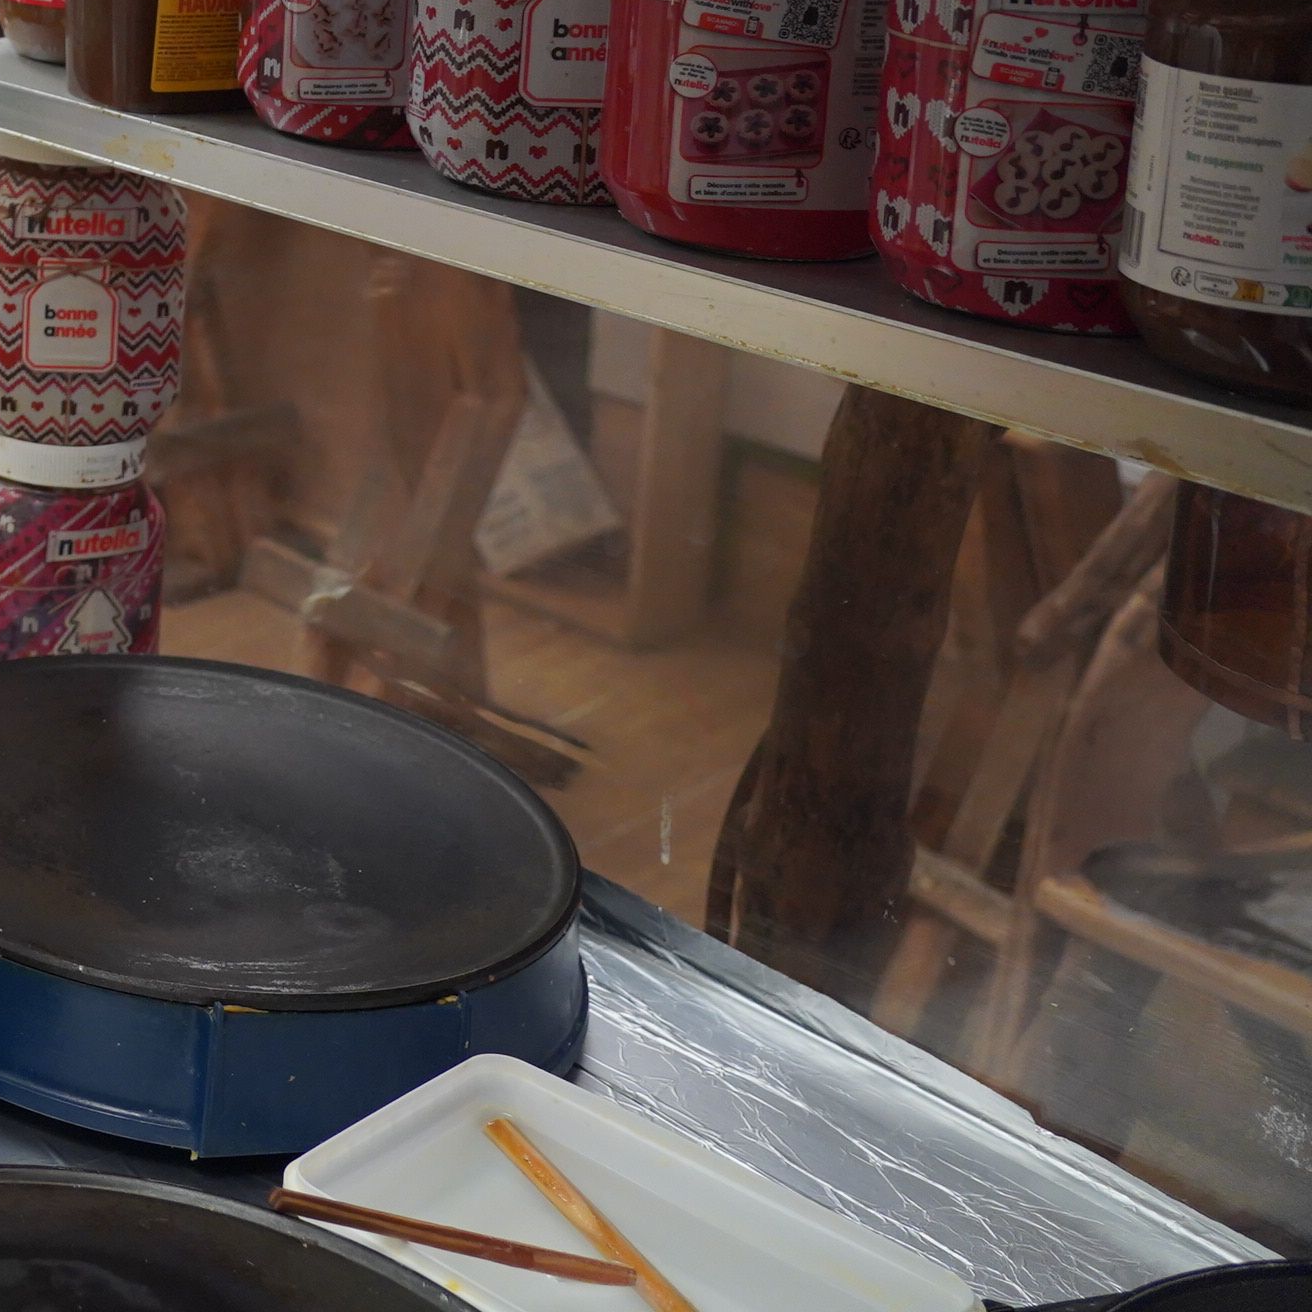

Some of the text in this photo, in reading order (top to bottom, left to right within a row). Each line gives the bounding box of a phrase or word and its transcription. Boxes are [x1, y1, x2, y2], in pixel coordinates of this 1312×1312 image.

[553, 18, 608, 39] bonn
[551, 43, 607, 62] anné
[27, 212, 126, 236] nutella
[45, 304, 98, 322] bonne
[44, 324, 97, 339] année
[59, 531, 140, 556] nutella
